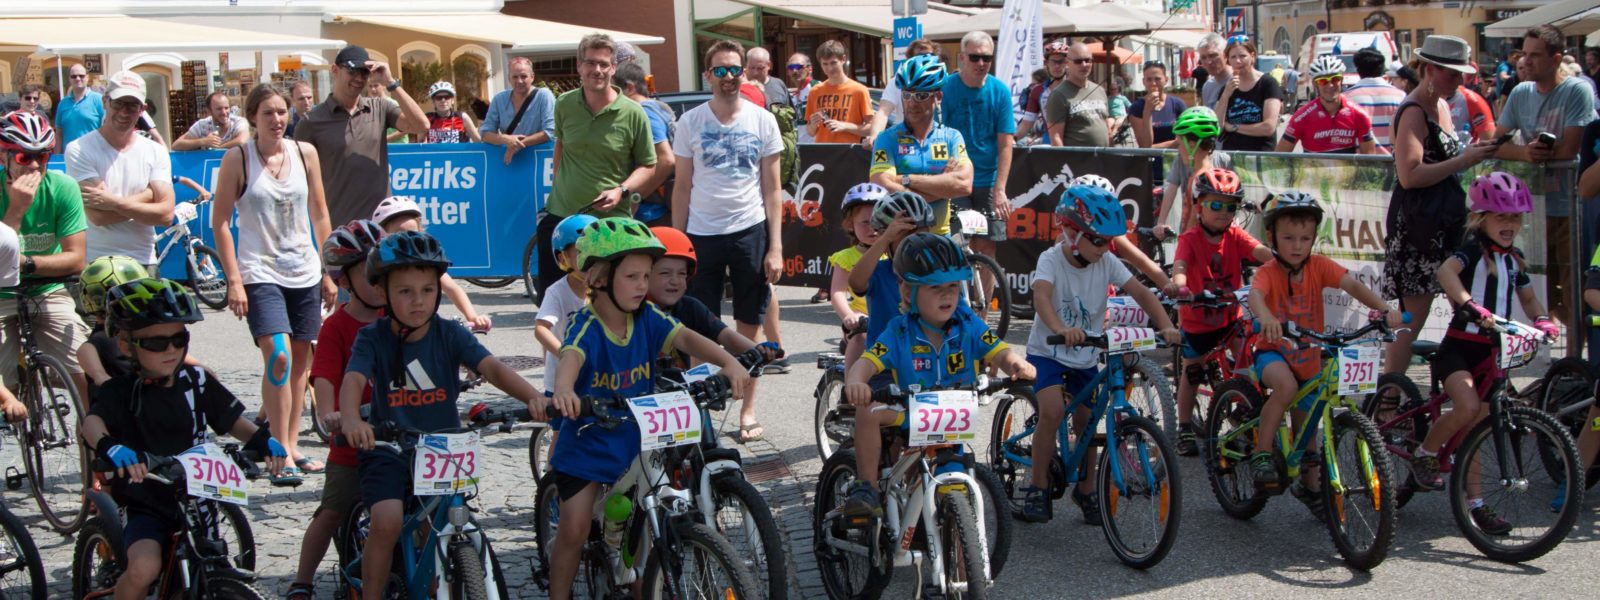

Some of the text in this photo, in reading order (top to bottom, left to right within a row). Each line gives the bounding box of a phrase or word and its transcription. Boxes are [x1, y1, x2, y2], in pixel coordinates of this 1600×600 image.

[898, 26, 913, 39] WC
[817, 94, 853, 108] KEEP IT
[389, 161, 476, 190] ezirks
[418, 196, 470, 225] tter
[1112, 306, 1145, 324] 3770
[1343, 361, 1375, 383] 3751
[387, 387, 447, 407] adidas
[643, 405, 691, 434] 3717
[917, 408, 971, 432] 3723
[188, 456, 242, 488] 3704
[422, 451, 475, 479] 3773
